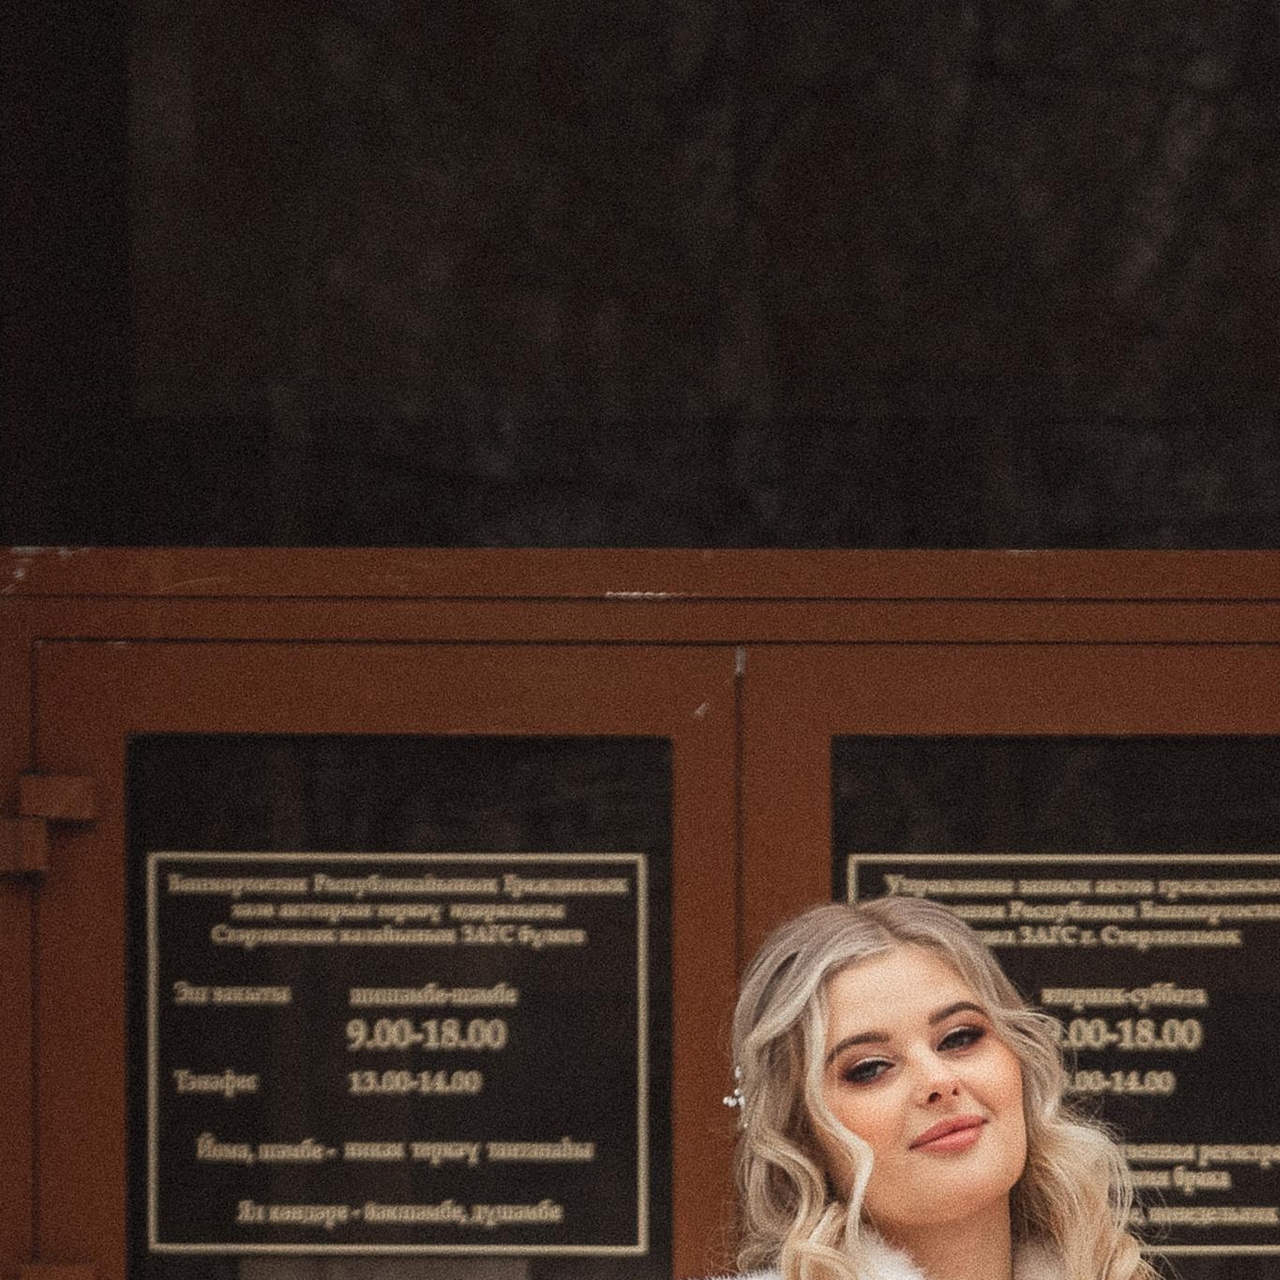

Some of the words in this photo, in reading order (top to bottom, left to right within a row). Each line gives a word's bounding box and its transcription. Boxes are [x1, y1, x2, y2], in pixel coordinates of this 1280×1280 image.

[347, 1018, 507, 1050] 9.00-18.00
[1056, 1019, 1202, 1050] .00-18.00
[349, 1071, 482, 1094] 13.00-14.00
